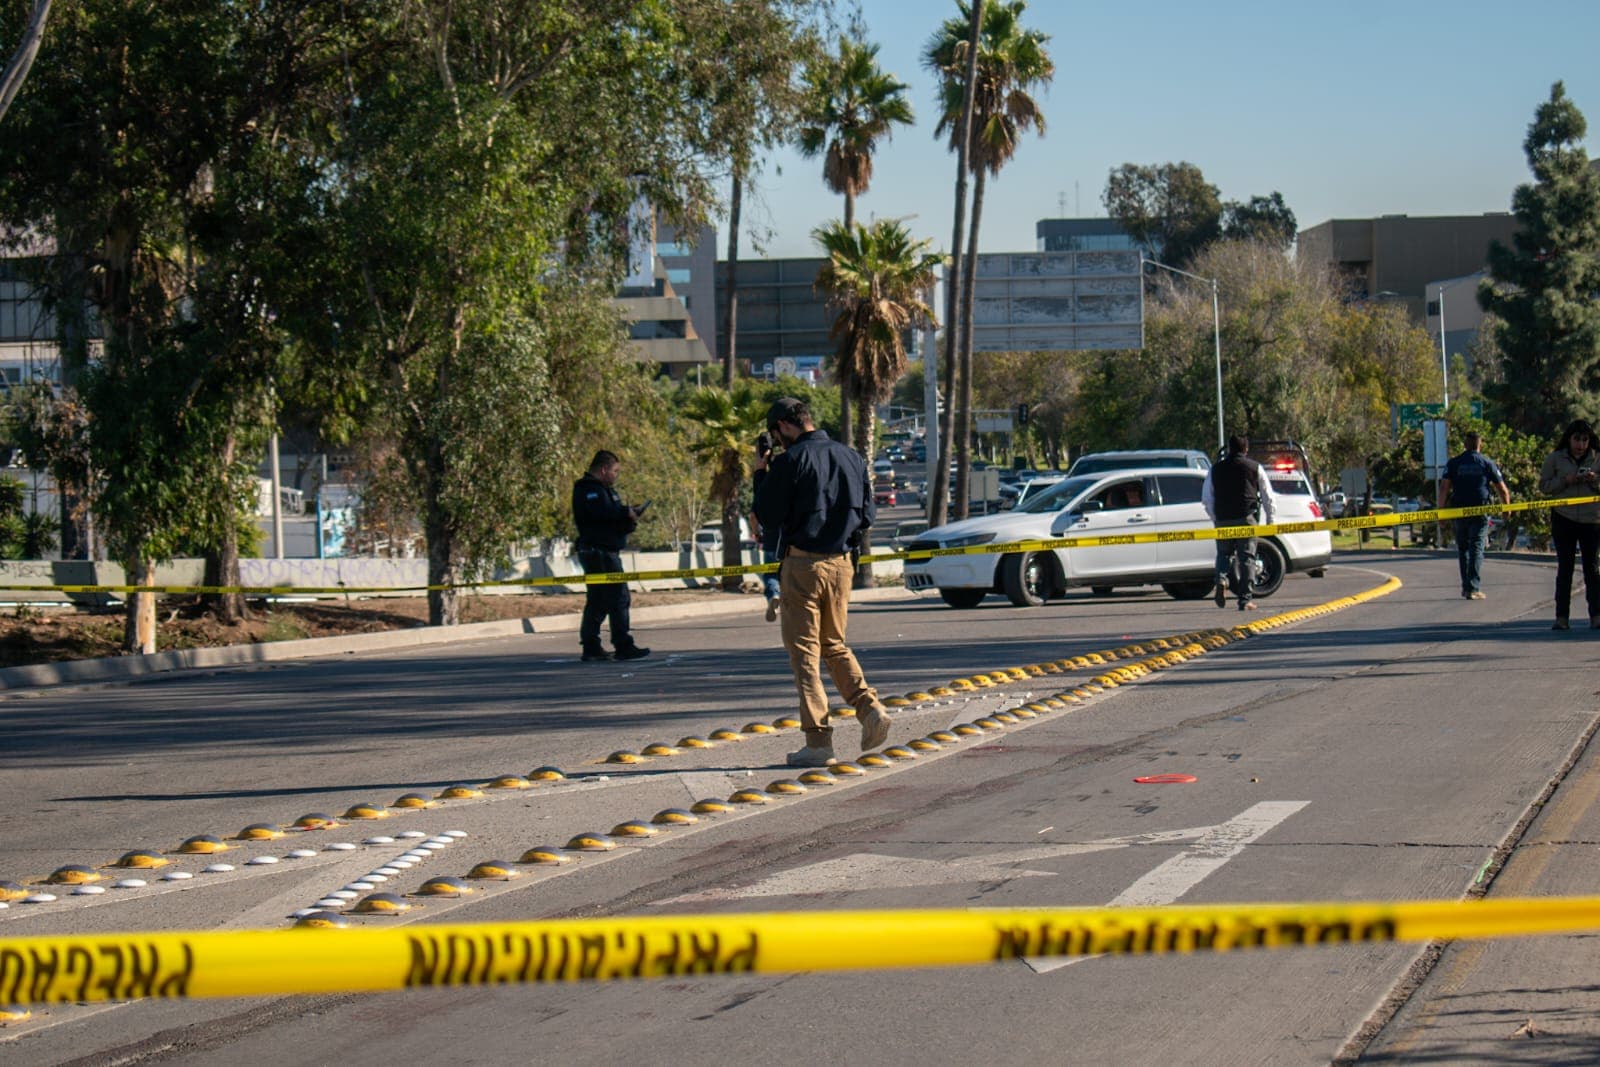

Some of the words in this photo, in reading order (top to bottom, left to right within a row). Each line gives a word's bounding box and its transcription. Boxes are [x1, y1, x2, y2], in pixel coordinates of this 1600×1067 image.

[1099, 534, 1136, 546] PRECAUCION
[1157, 531, 1195, 542] PRECAUCION
[1217, 528, 1256, 538] PRECAUCION
[1276, 522, 1316, 534] PRECAUCION
[1337, 517, 1377, 529] PRECAUCION
[1399, 511, 1440, 523] PRECAUCION
[1462, 504, 1503, 517] PRECAUCION
